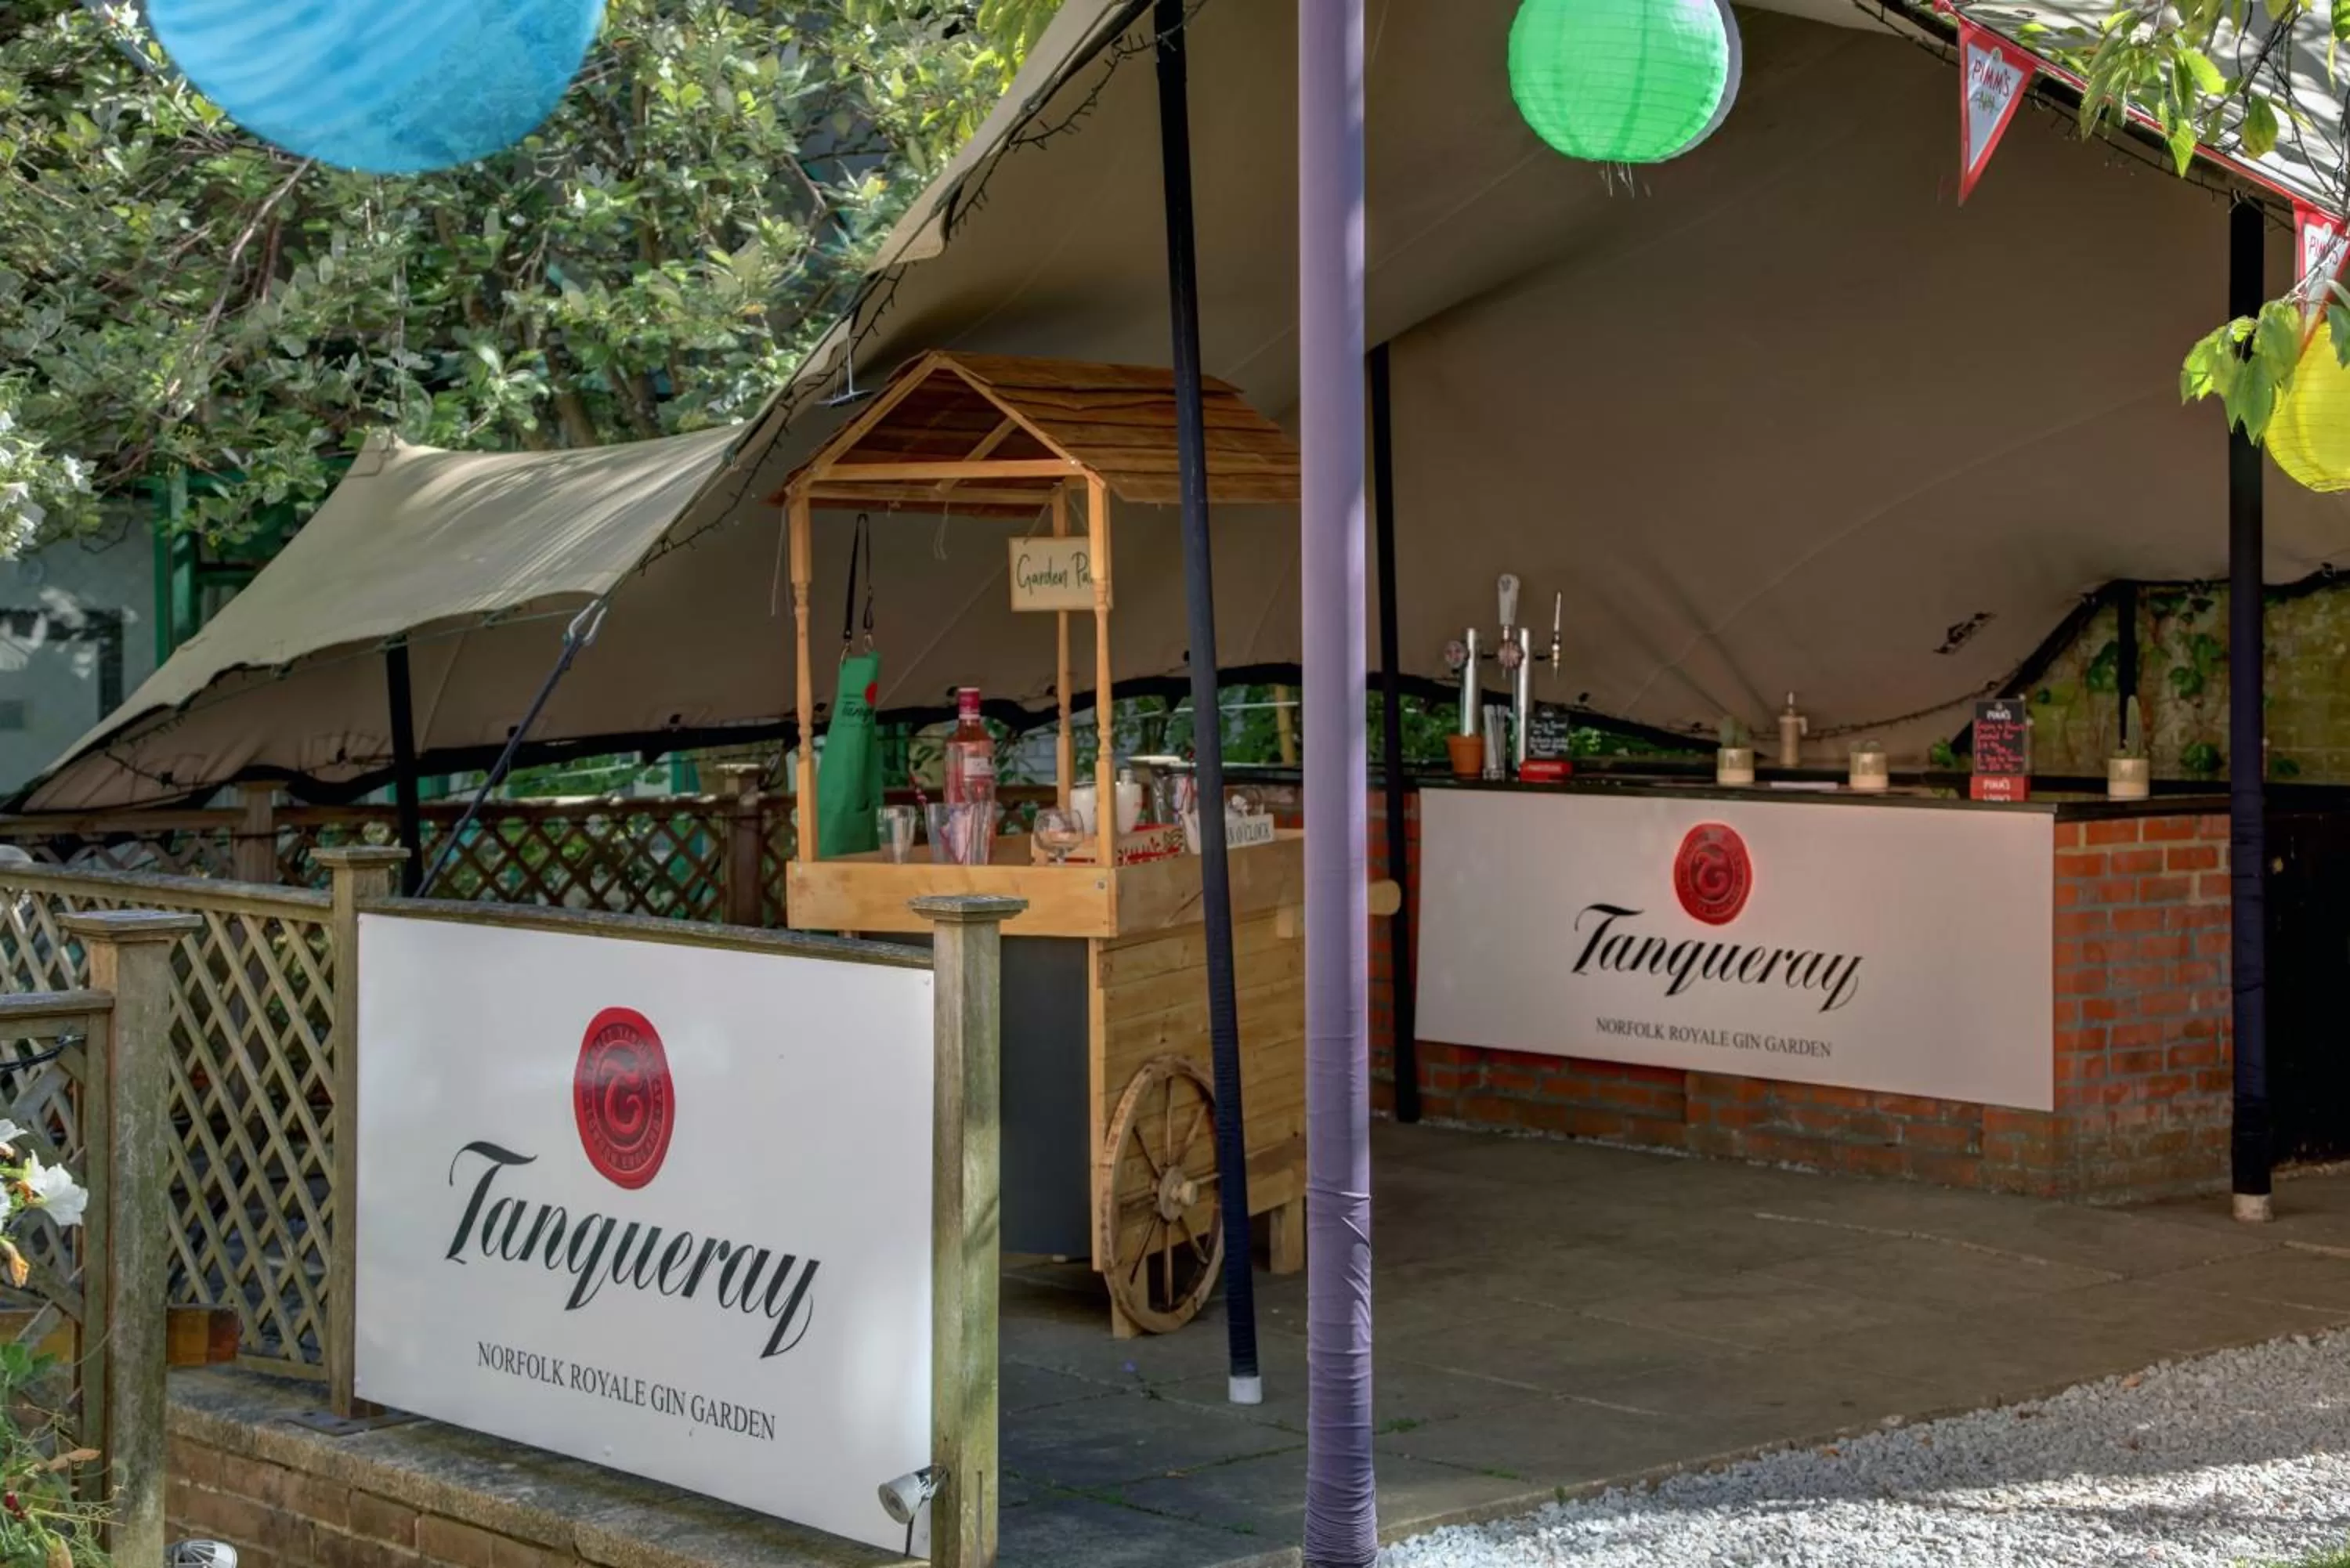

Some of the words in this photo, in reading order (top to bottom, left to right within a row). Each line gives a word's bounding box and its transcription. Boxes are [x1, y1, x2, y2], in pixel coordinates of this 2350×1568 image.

[1017, 553, 1068, 596] Garden
[1571, 902, 1864, 1013] Tanqueray
[1596, 1017, 1665, 1041] NORFOLK
[1668, 1024, 1730, 1048] ROYALE
[1732, 1031, 1762, 1050] GIN
[1764, 1035, 1832, 1058] GARDEN
[445, 1140, 821, 1360] Tanqueray
[477, 1340, 565, 1387] NORFOLK
[569, 1363, 646, 1407] ROYALE
[650, 1383, 687, 1418] GIN
[689, 1393, 777, 1442] GARDEN
